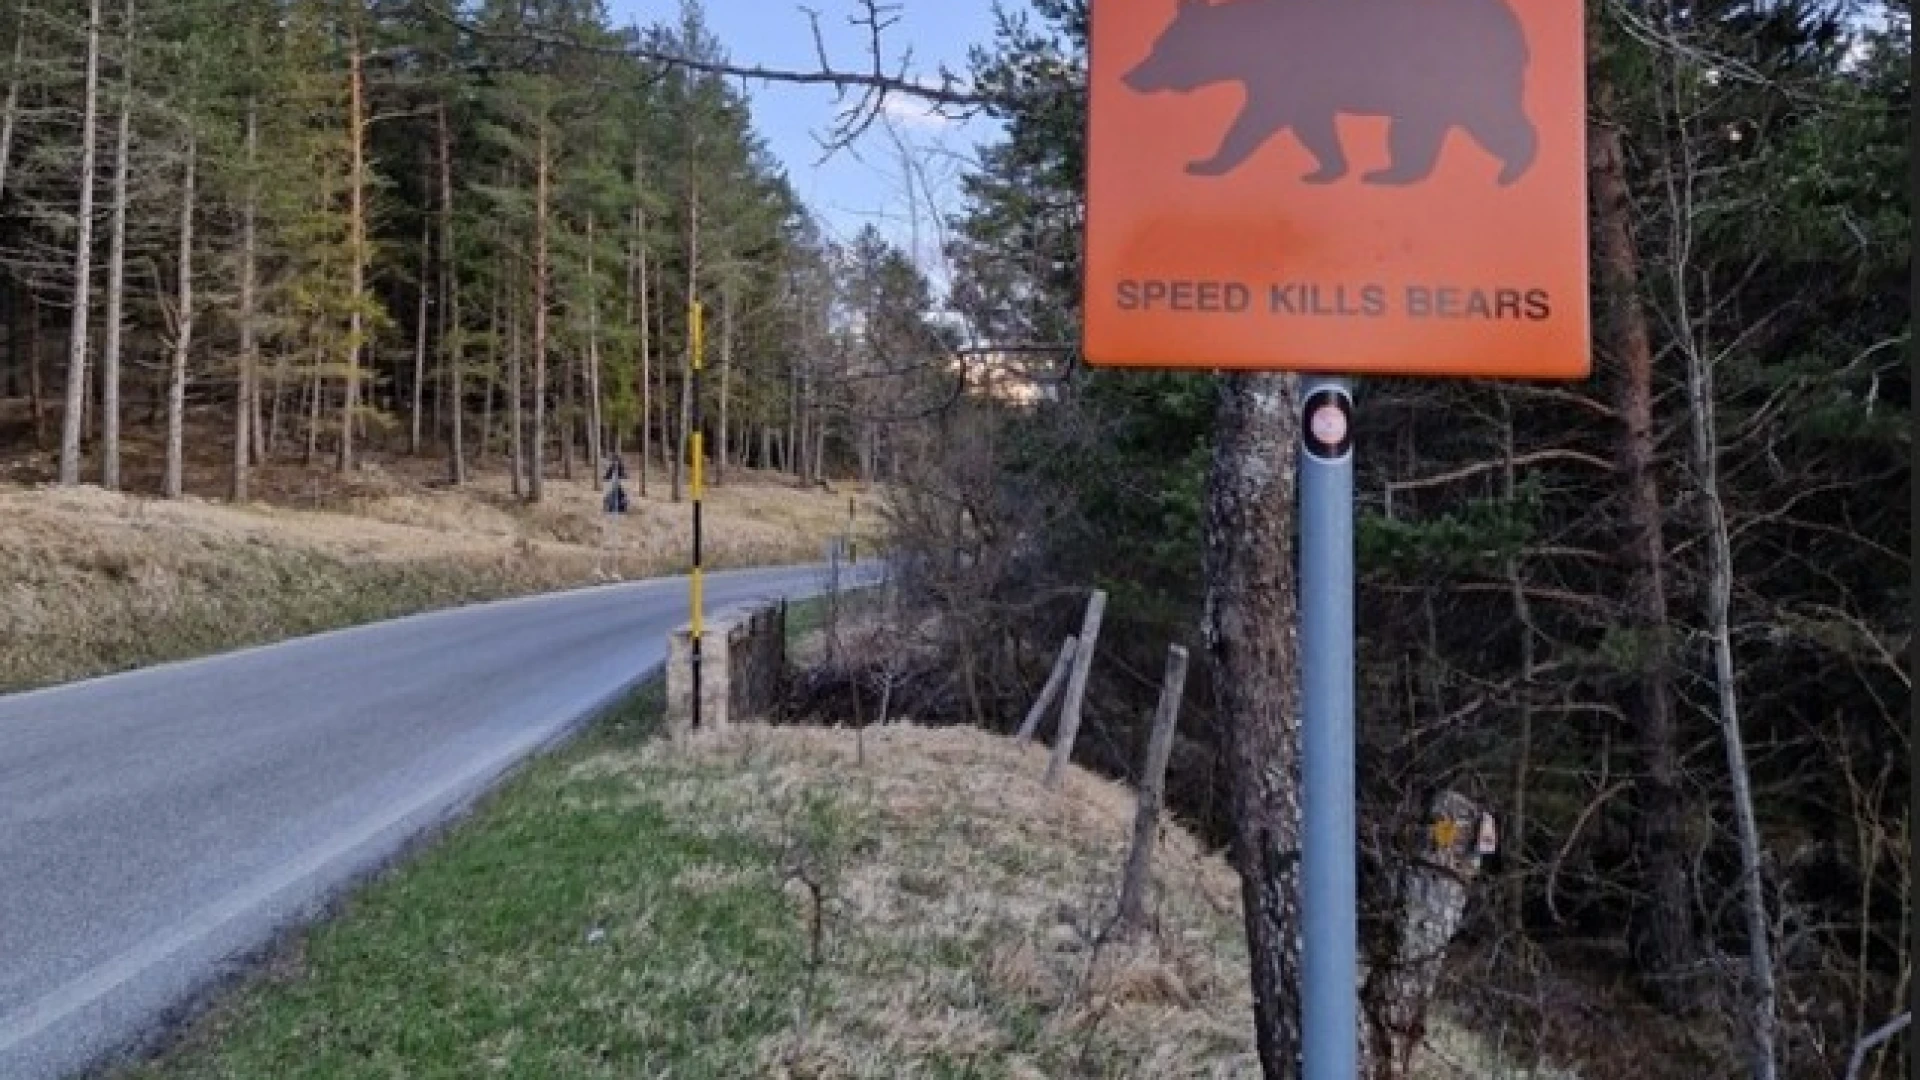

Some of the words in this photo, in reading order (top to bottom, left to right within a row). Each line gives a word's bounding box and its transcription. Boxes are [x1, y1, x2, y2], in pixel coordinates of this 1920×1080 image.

[1116, 280, 1250, 313] SPEED
[1268, 284, 1387, 317] KILLS
[1405, 286, 1551, 320] BEARS
